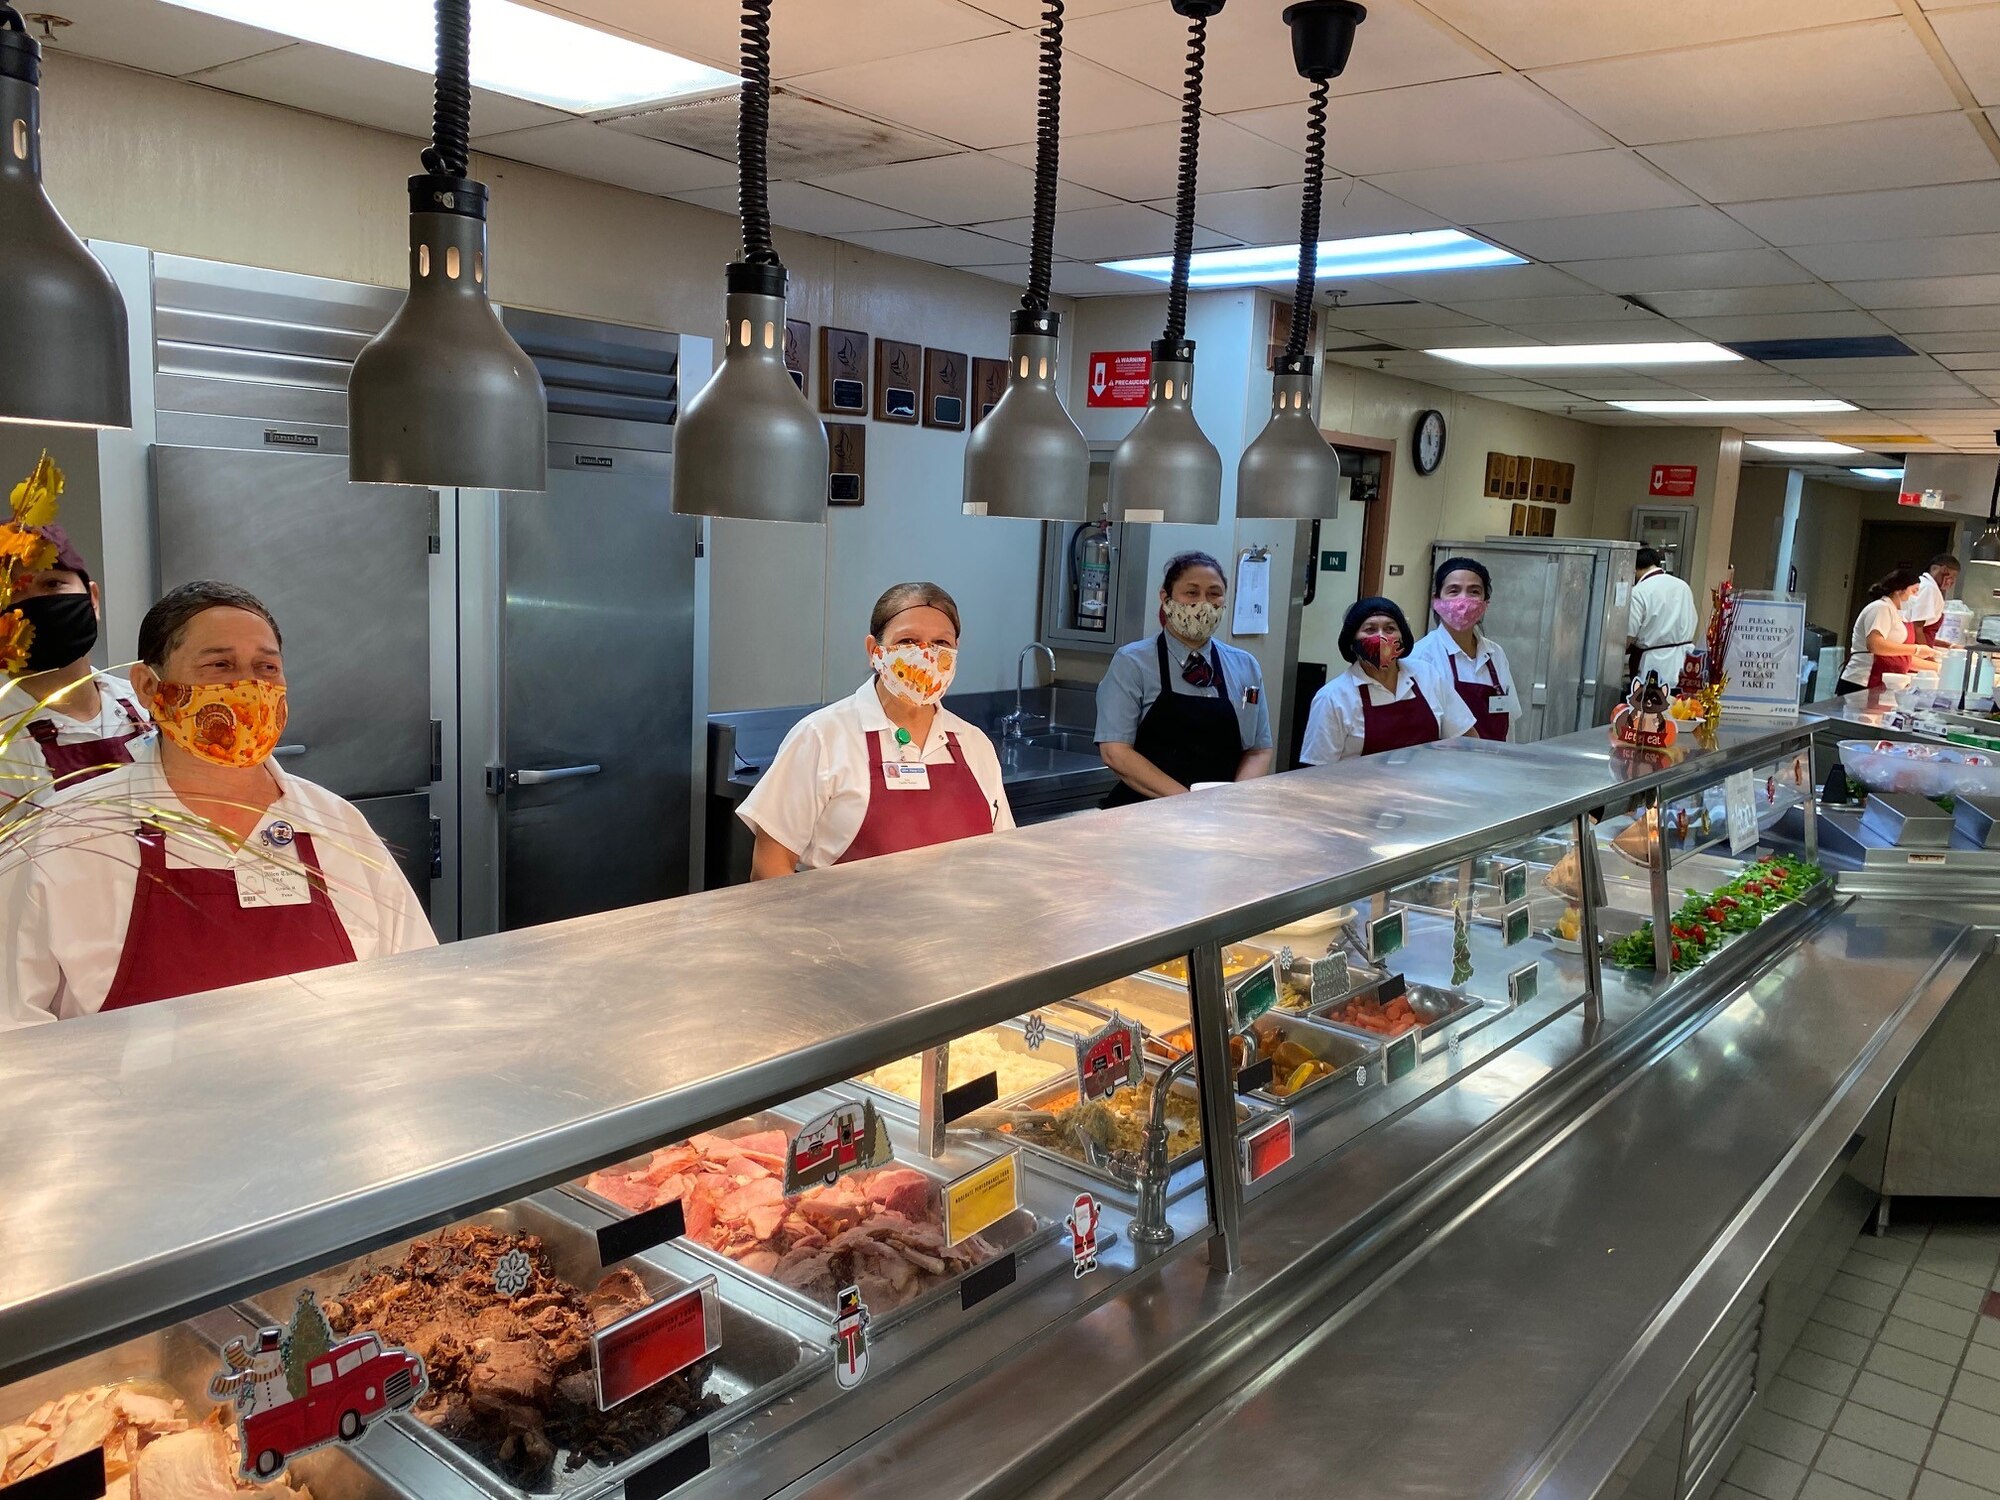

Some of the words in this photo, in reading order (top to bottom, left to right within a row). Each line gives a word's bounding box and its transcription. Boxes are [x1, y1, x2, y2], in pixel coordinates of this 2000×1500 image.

[1329, 556, 1339, 566] IN
[1748, 617, 1775, 625] PLEASE
[1740, 660, 1769, 669] TOUCH
[1771, 662, 1780, 670] IT
[1742, 670, 1775, 679] PLEASE
[1741, 680, 1763, 689] TAKE
[1647, 735, 1661, 745] eat
